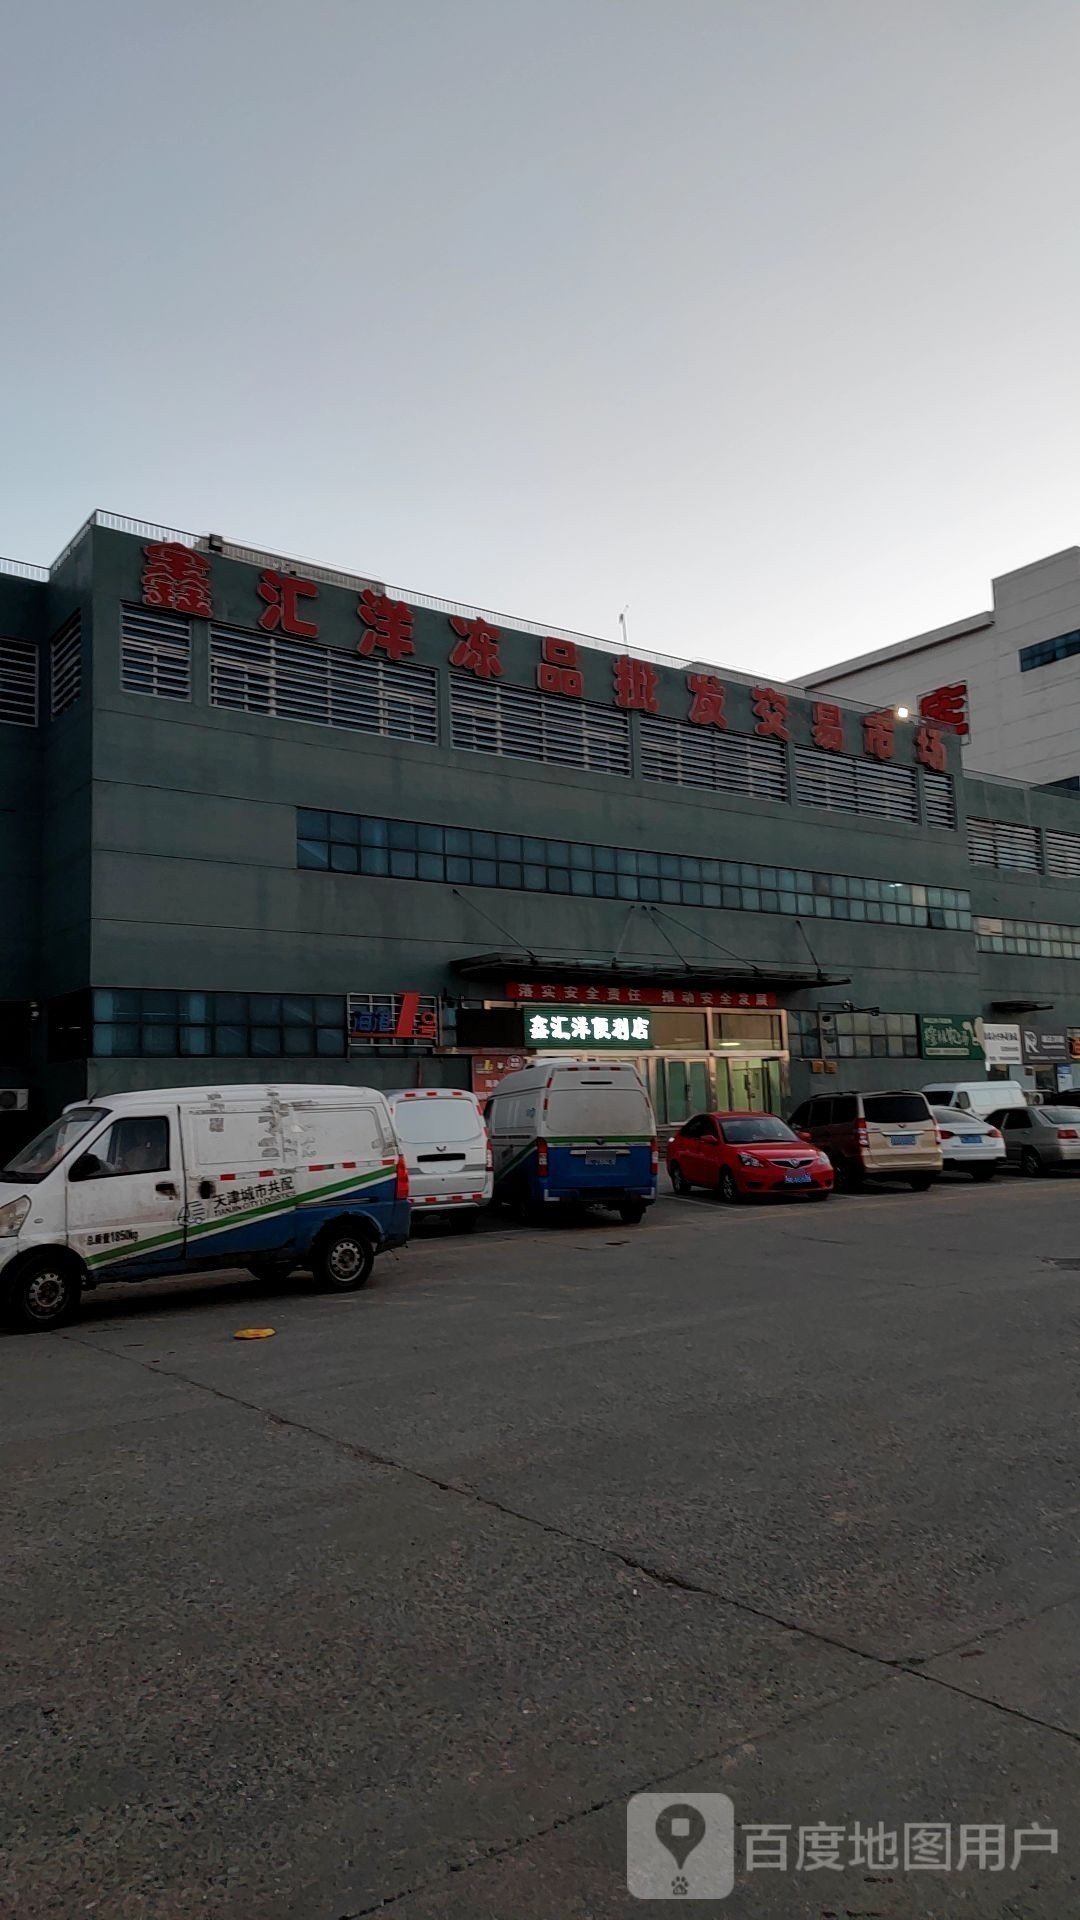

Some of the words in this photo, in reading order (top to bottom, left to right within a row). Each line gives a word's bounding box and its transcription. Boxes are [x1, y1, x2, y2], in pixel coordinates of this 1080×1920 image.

[141, 541, 949, 771] 鑫汇洋冻品批发交易市场
[517, 983, 641, 1001] 落实安全责任
[529, 1014, 650, 1041] 鑫汇洋便利店
[213, 1176, 294, 1209] 天津城市共配
